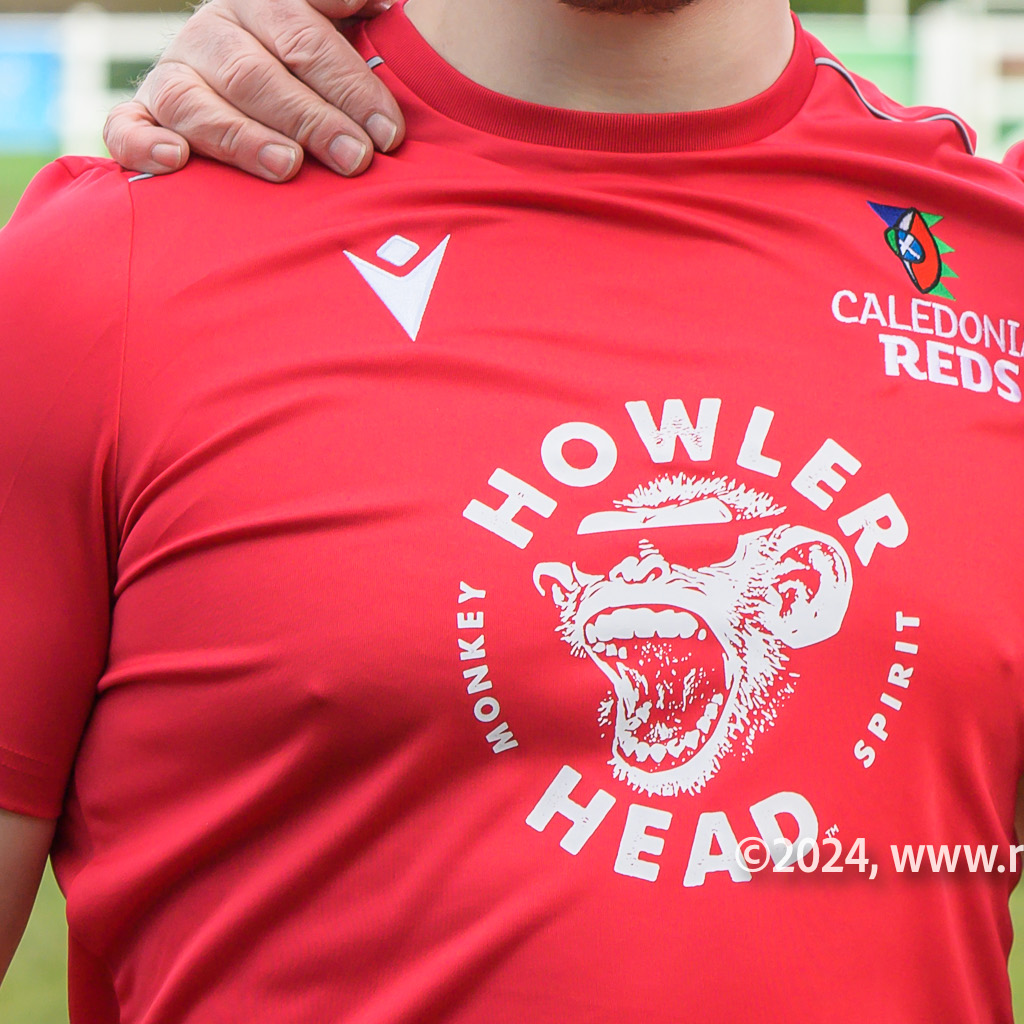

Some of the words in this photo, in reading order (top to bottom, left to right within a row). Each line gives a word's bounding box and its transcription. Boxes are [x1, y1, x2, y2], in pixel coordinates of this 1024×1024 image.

[878, 333, 1022, 403] REDS
[462, 397, 909, 567] HOWLER
[456, 580, 519, 754] MONKEY
[853, 611, 921, 768] SPIRIT
[525, 765, 819, 888] HEAD
